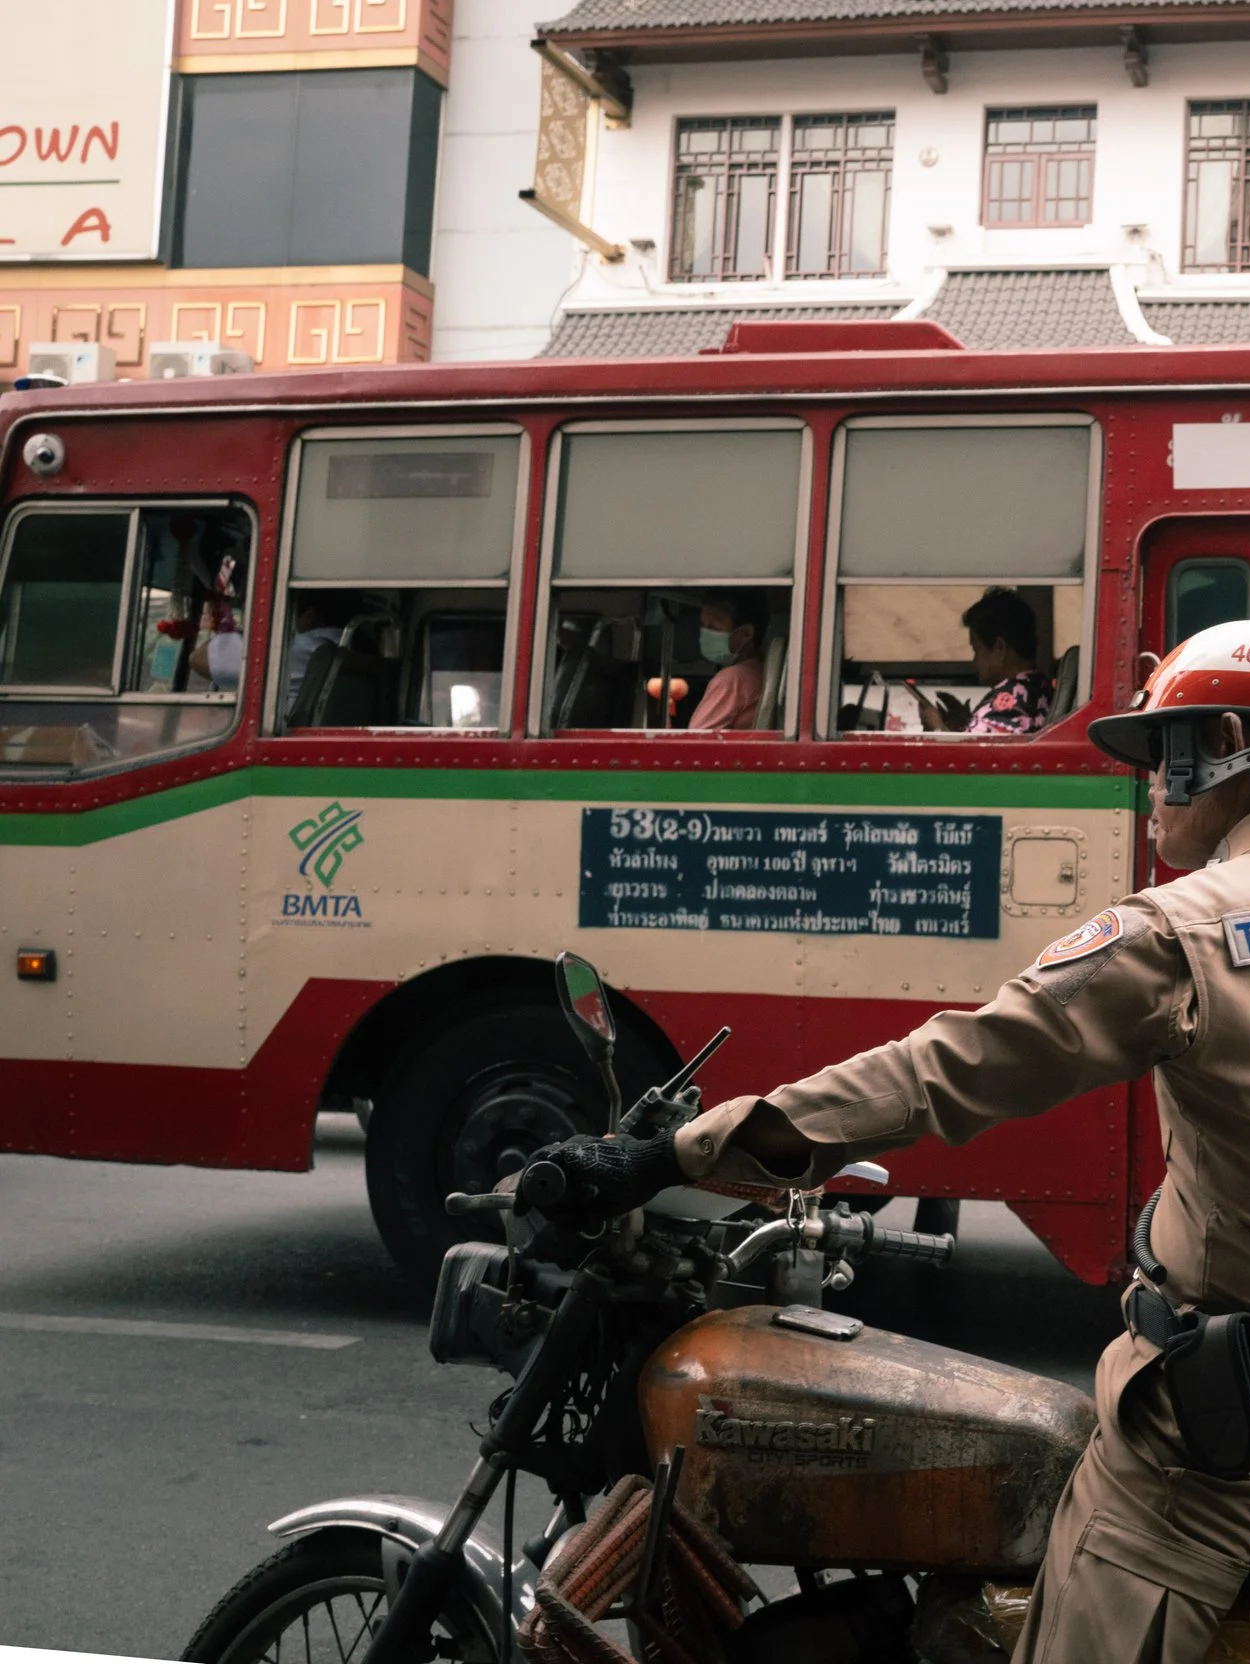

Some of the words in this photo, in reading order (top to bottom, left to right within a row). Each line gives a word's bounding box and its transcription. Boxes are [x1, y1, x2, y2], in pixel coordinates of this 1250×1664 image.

[282, 893, 362, 917] BMTA
[694, 1408, 878, 1454] Kawasaki
[795, 1453, 868, 1469] SPORTS
